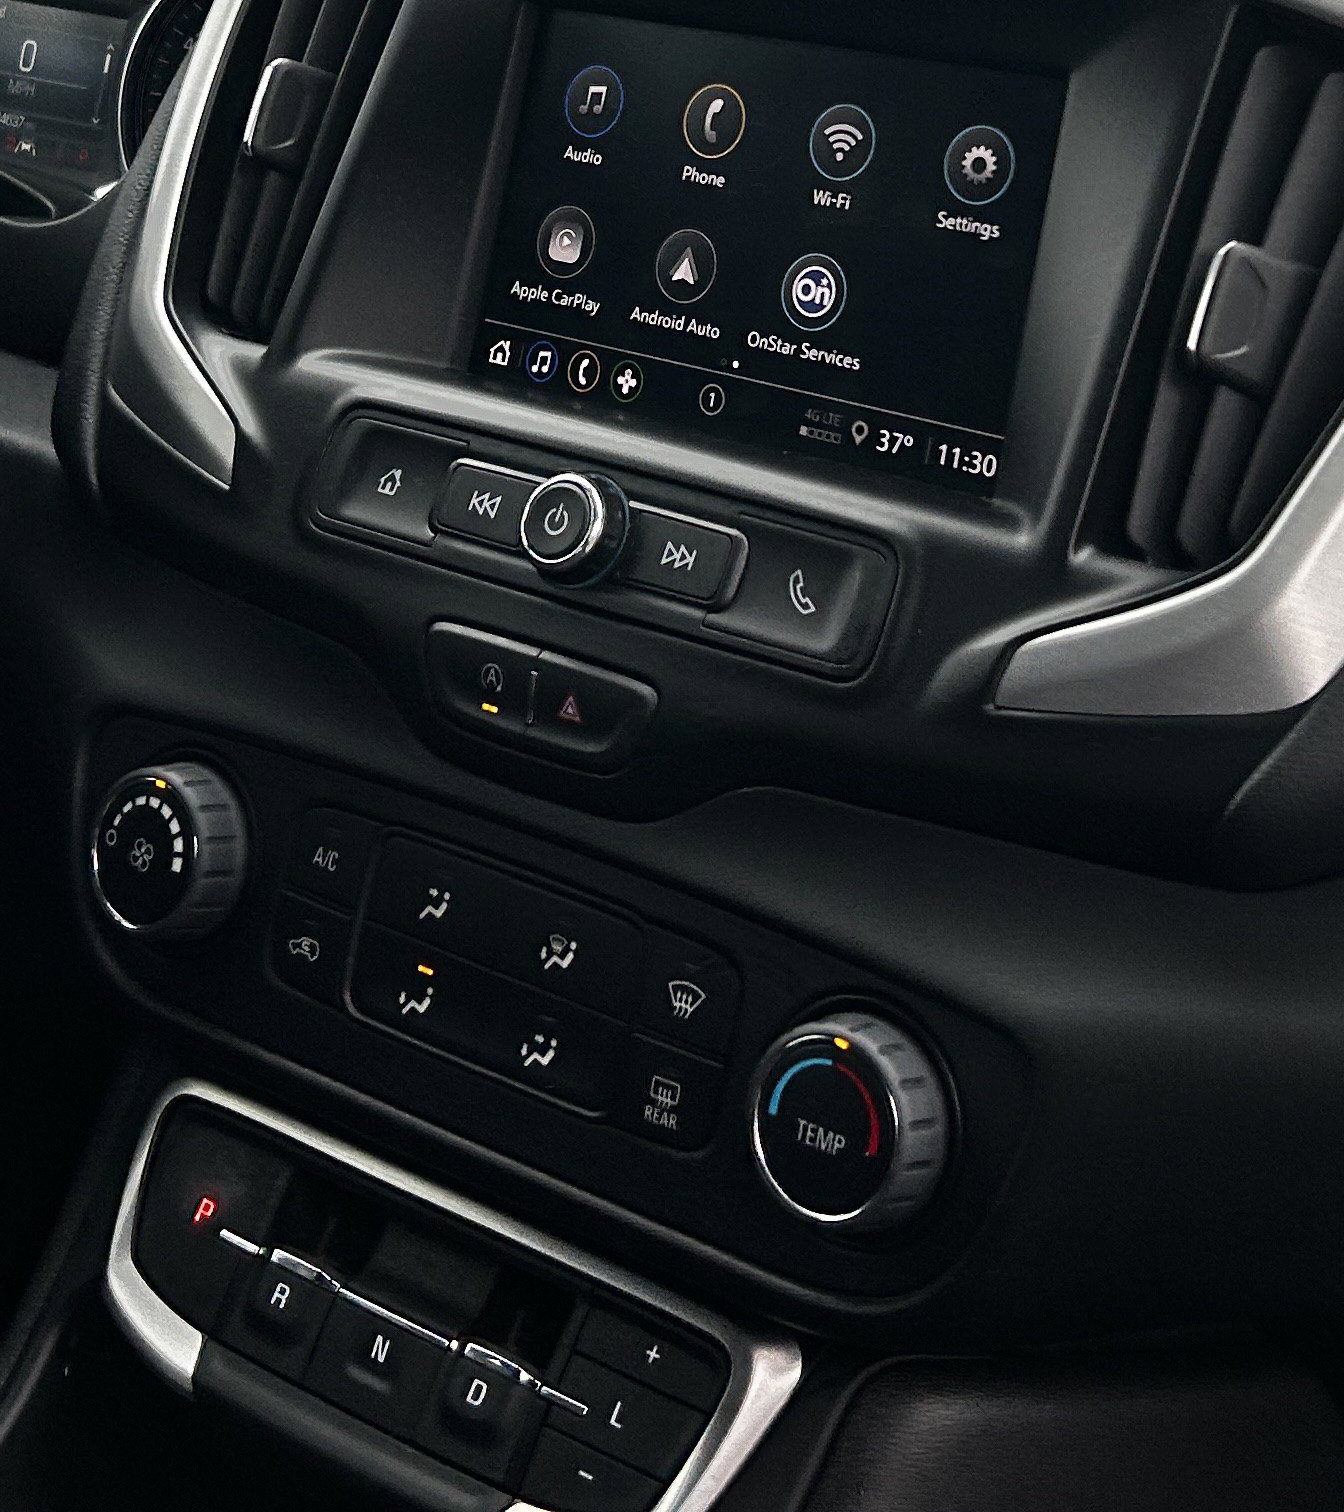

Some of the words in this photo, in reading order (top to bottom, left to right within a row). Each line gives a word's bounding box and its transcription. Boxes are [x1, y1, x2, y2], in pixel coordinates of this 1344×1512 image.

[19, 39, 37, 73] 0
[563, 145, 603, 166] Audio
[681, 165, 726, 188] Phone
[812, 188, 852, 210] Wi-Fi
[935, 210, 1001, 241] Settings
[510, 280, 549, 303] Apple
[552, 289, 601, 317] CarPlay
[629, 306, 685, 331] Android
[686, 318, 721, 339] Auto
[747, 331, 797, 356] OnStar
[799, 342, 861, 370] Services
[938, 444, 998, 477] 11:30
[312, 846, 339, 872] A/C
[644, 1104, 678, 1131] REAR
[796, 1117, 846, 1156] TEMP
[192, 1197, 217, 1224] P
[270, 1282, 291, 1309] R
[370, 1334, 391, 1364] N
[466, 1378, 488, 1407] D
[609, 1400, 623, 1429] L
